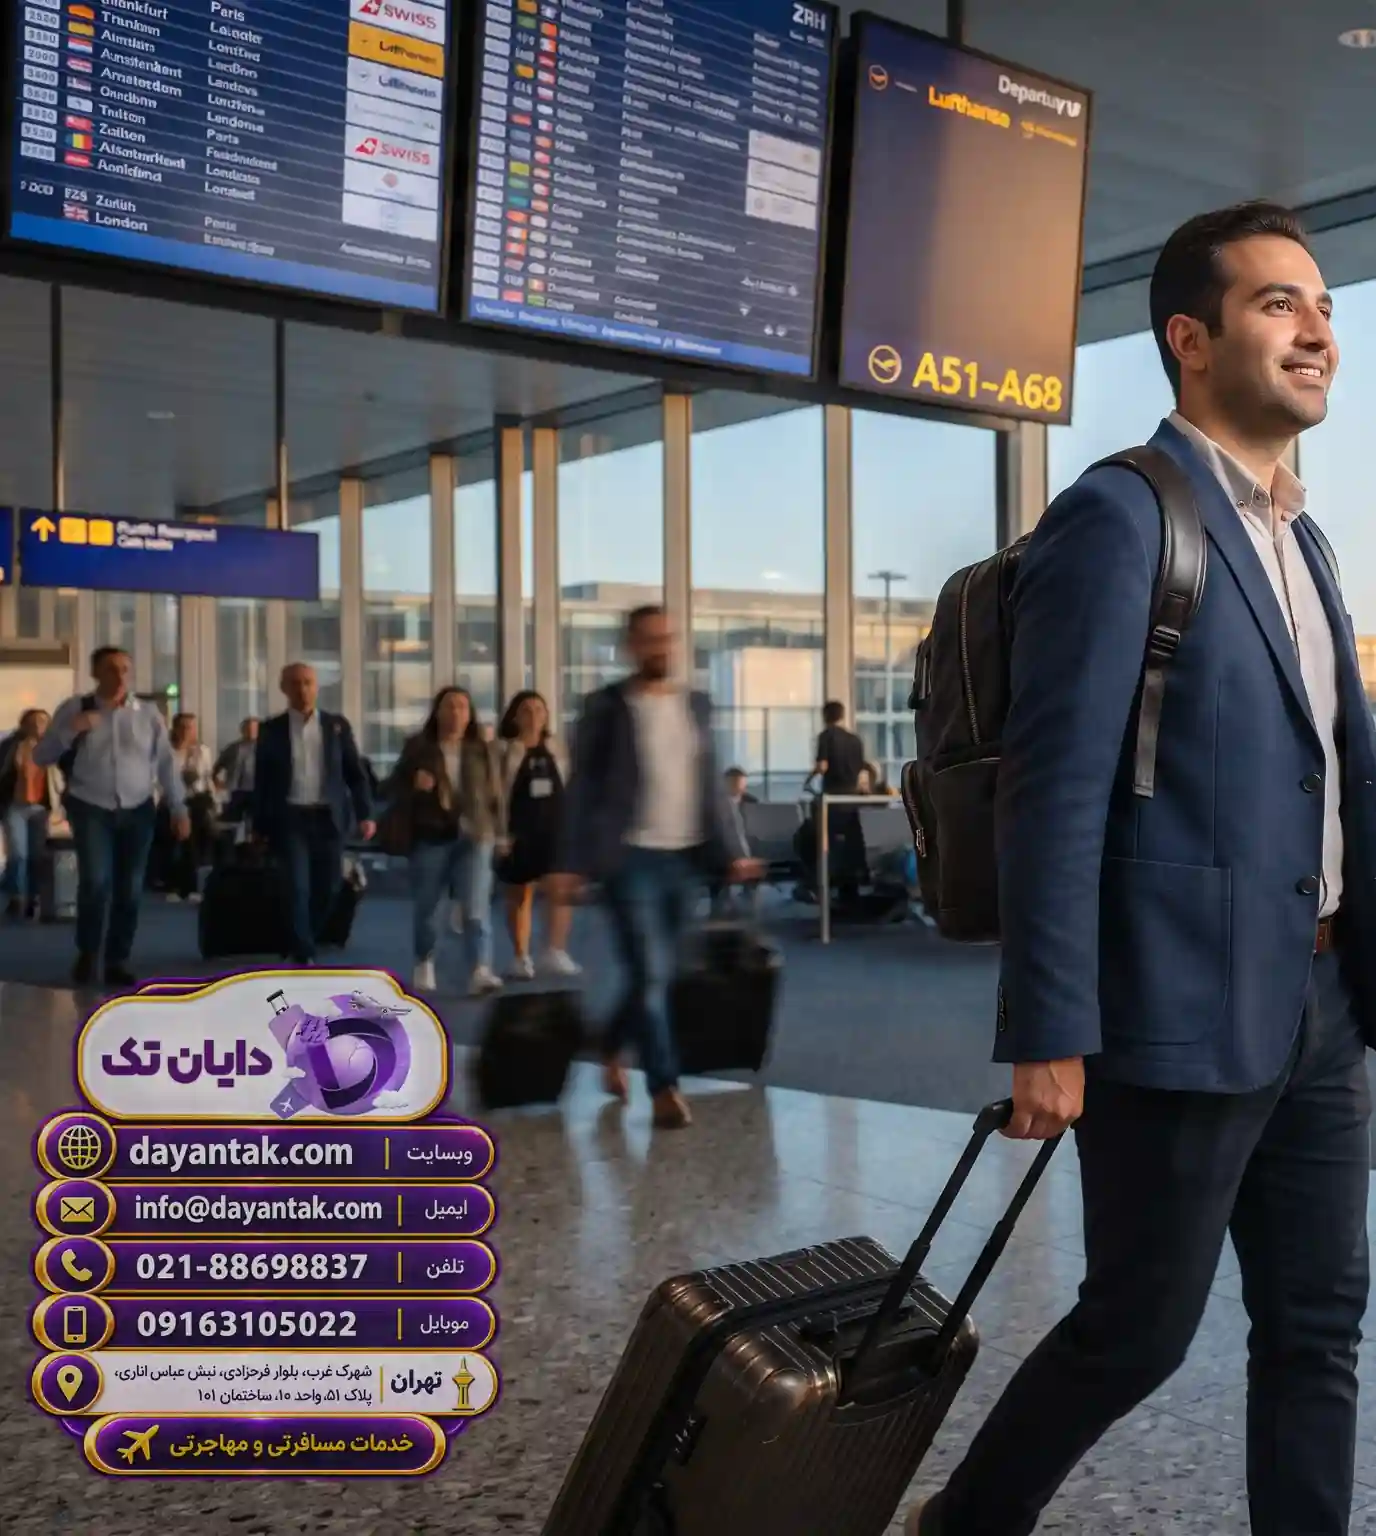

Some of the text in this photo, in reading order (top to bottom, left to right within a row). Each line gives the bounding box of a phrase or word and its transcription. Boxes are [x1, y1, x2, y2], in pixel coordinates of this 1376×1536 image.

[383, 4, 437, 30] SWISS
[380, 142, 431, 165] SWISS
[95, 212, 148, 232] London
